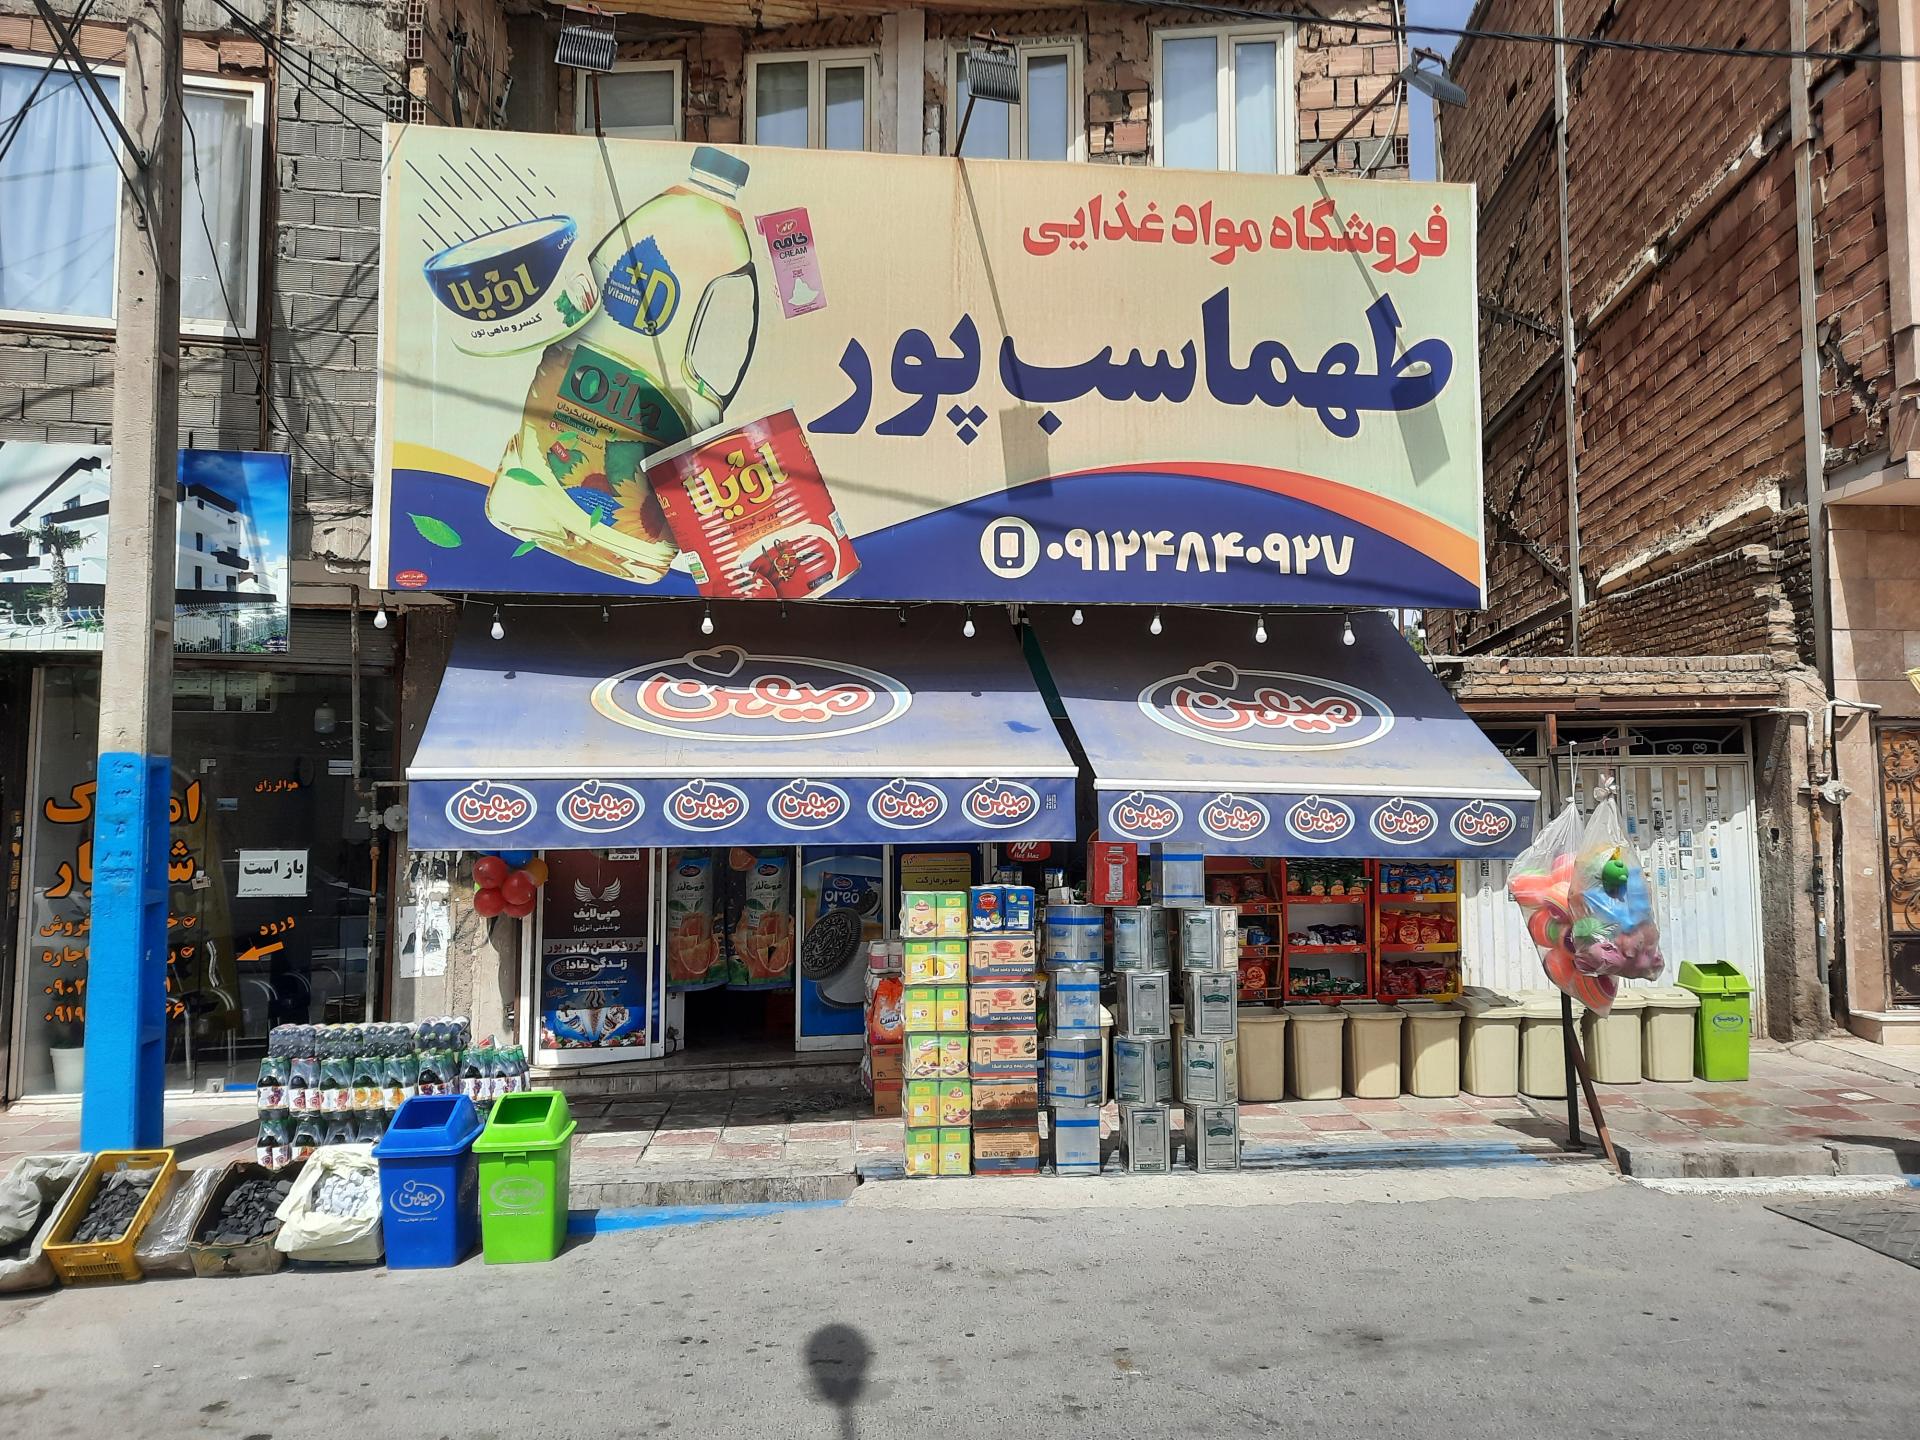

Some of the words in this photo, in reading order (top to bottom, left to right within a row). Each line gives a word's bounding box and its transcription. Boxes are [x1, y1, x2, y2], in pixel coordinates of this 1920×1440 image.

[1022, 190, 1166, 258] غذایی
[1171, 199, 1262, 266] مواد
[1271, 196, 1450, 275] فروشگاه
[772, 232, 808, 251] خامه
[779, 246, 808, 260] CREAM
[607, 285, 640, 307] Vitamin
[470, 328, 486, 339] تون
[486, 324, 511, 338] ماهی
[997, 286, 1454, 438] طهماسب
[806, 312, 988, 446] پور
[570, 364, 662, 432] Oila
[682, 442, 790, 521] اویلا
[1046, 527, 1356, 577] ۰۹۱۲۴۸۴۰۹۲۷
[636, 673, 875, 724] میهن
[1171, 686, 1363, 735] میهن
[458, 791, 527, 826] میهن
[569, 789, 637, 823] میهن
[674, 788, 740, 822] میهن
[777, 788, 842, 821] میهن
[877, 788, 940, 819] میهن
[972, 787, 1033, 819] میهن
[1119, 806, 1174, 831] میهن
[1207, 807, 1263, 832] میهن
[1294, 809, 1347, 834] میهن
[1379, 811, 1431, 835] میهن
[1458, 812, 1512, 837] میهن
[243, 859, 279, 876] است
[282, 859, 304, 880] باز
[259, 914, 296, 936] ورود
[590, 956, 628, 972] زندگی
[399, 1191, 437, 1208] میهن
